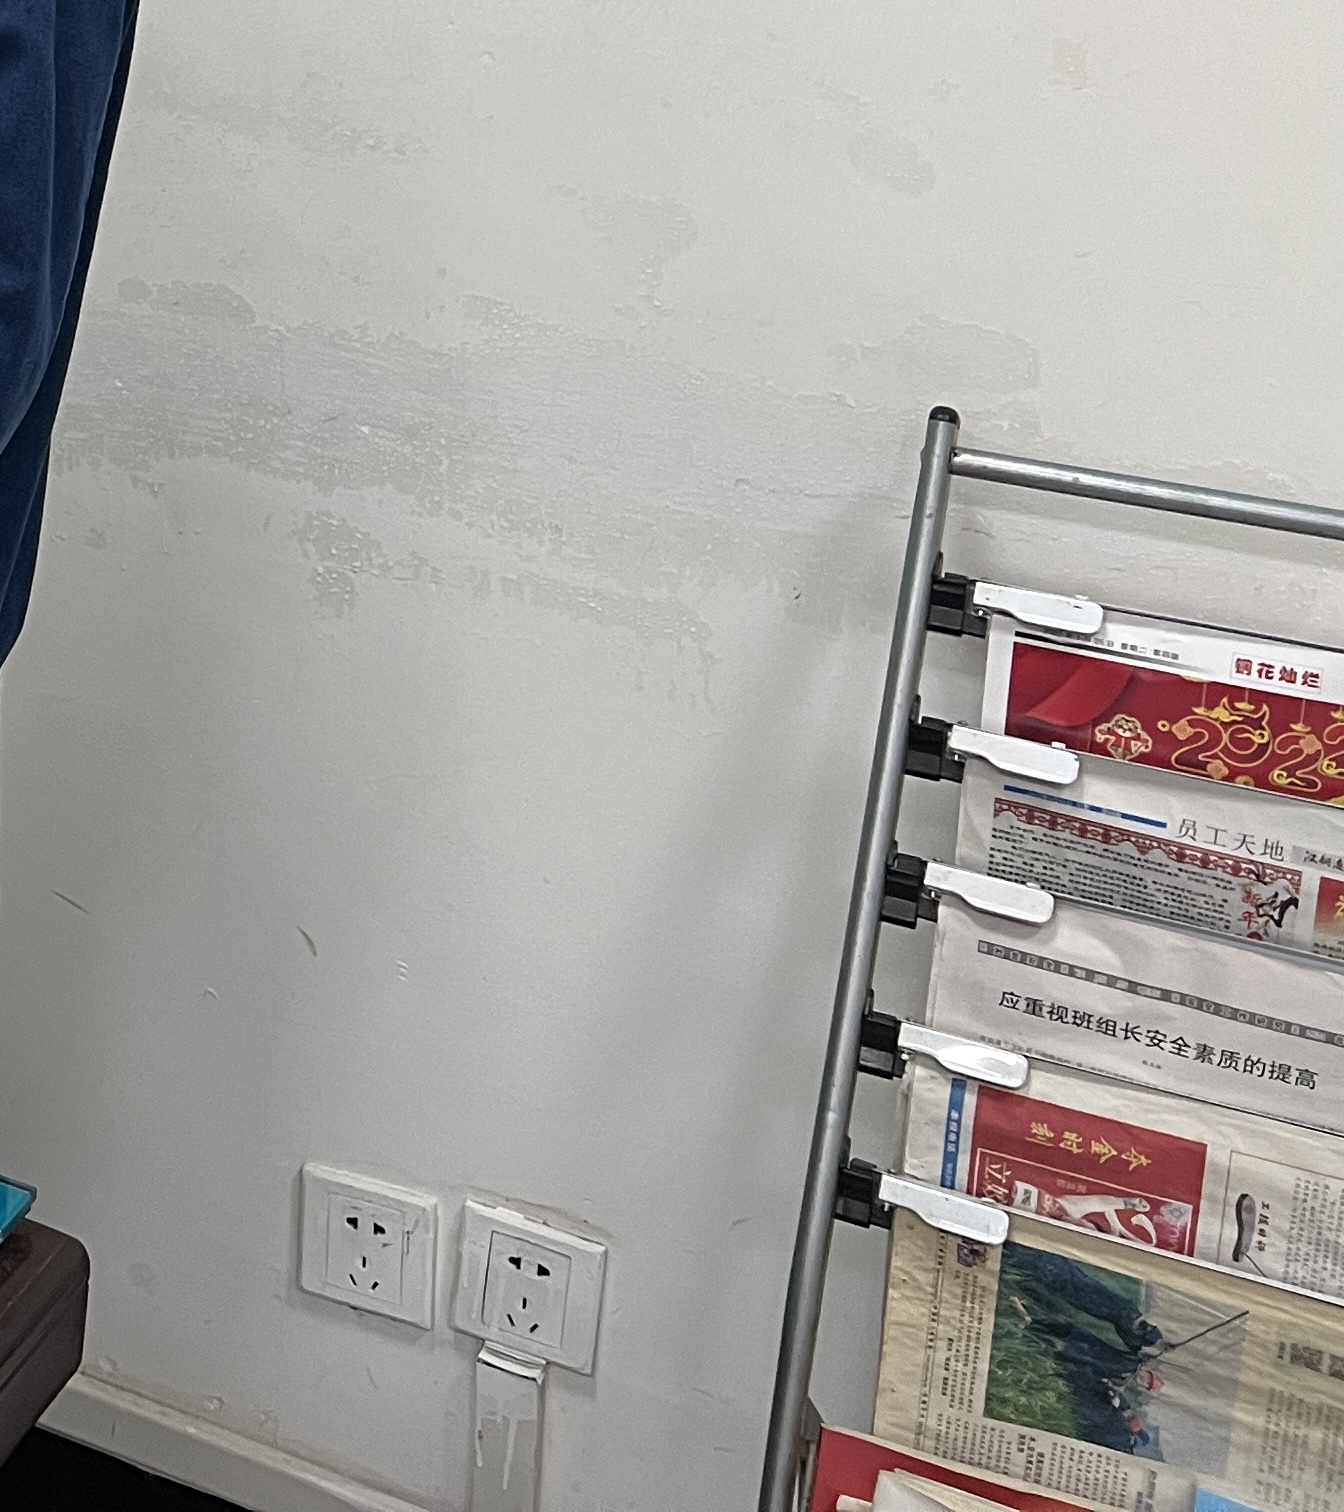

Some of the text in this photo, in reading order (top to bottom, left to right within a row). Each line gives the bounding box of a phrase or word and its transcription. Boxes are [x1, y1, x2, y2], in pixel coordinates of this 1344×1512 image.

[1178, 818, 1285, 863] 员工天地
[998, 990, 1319, 1090] 应重视班组长安全素质的提高
